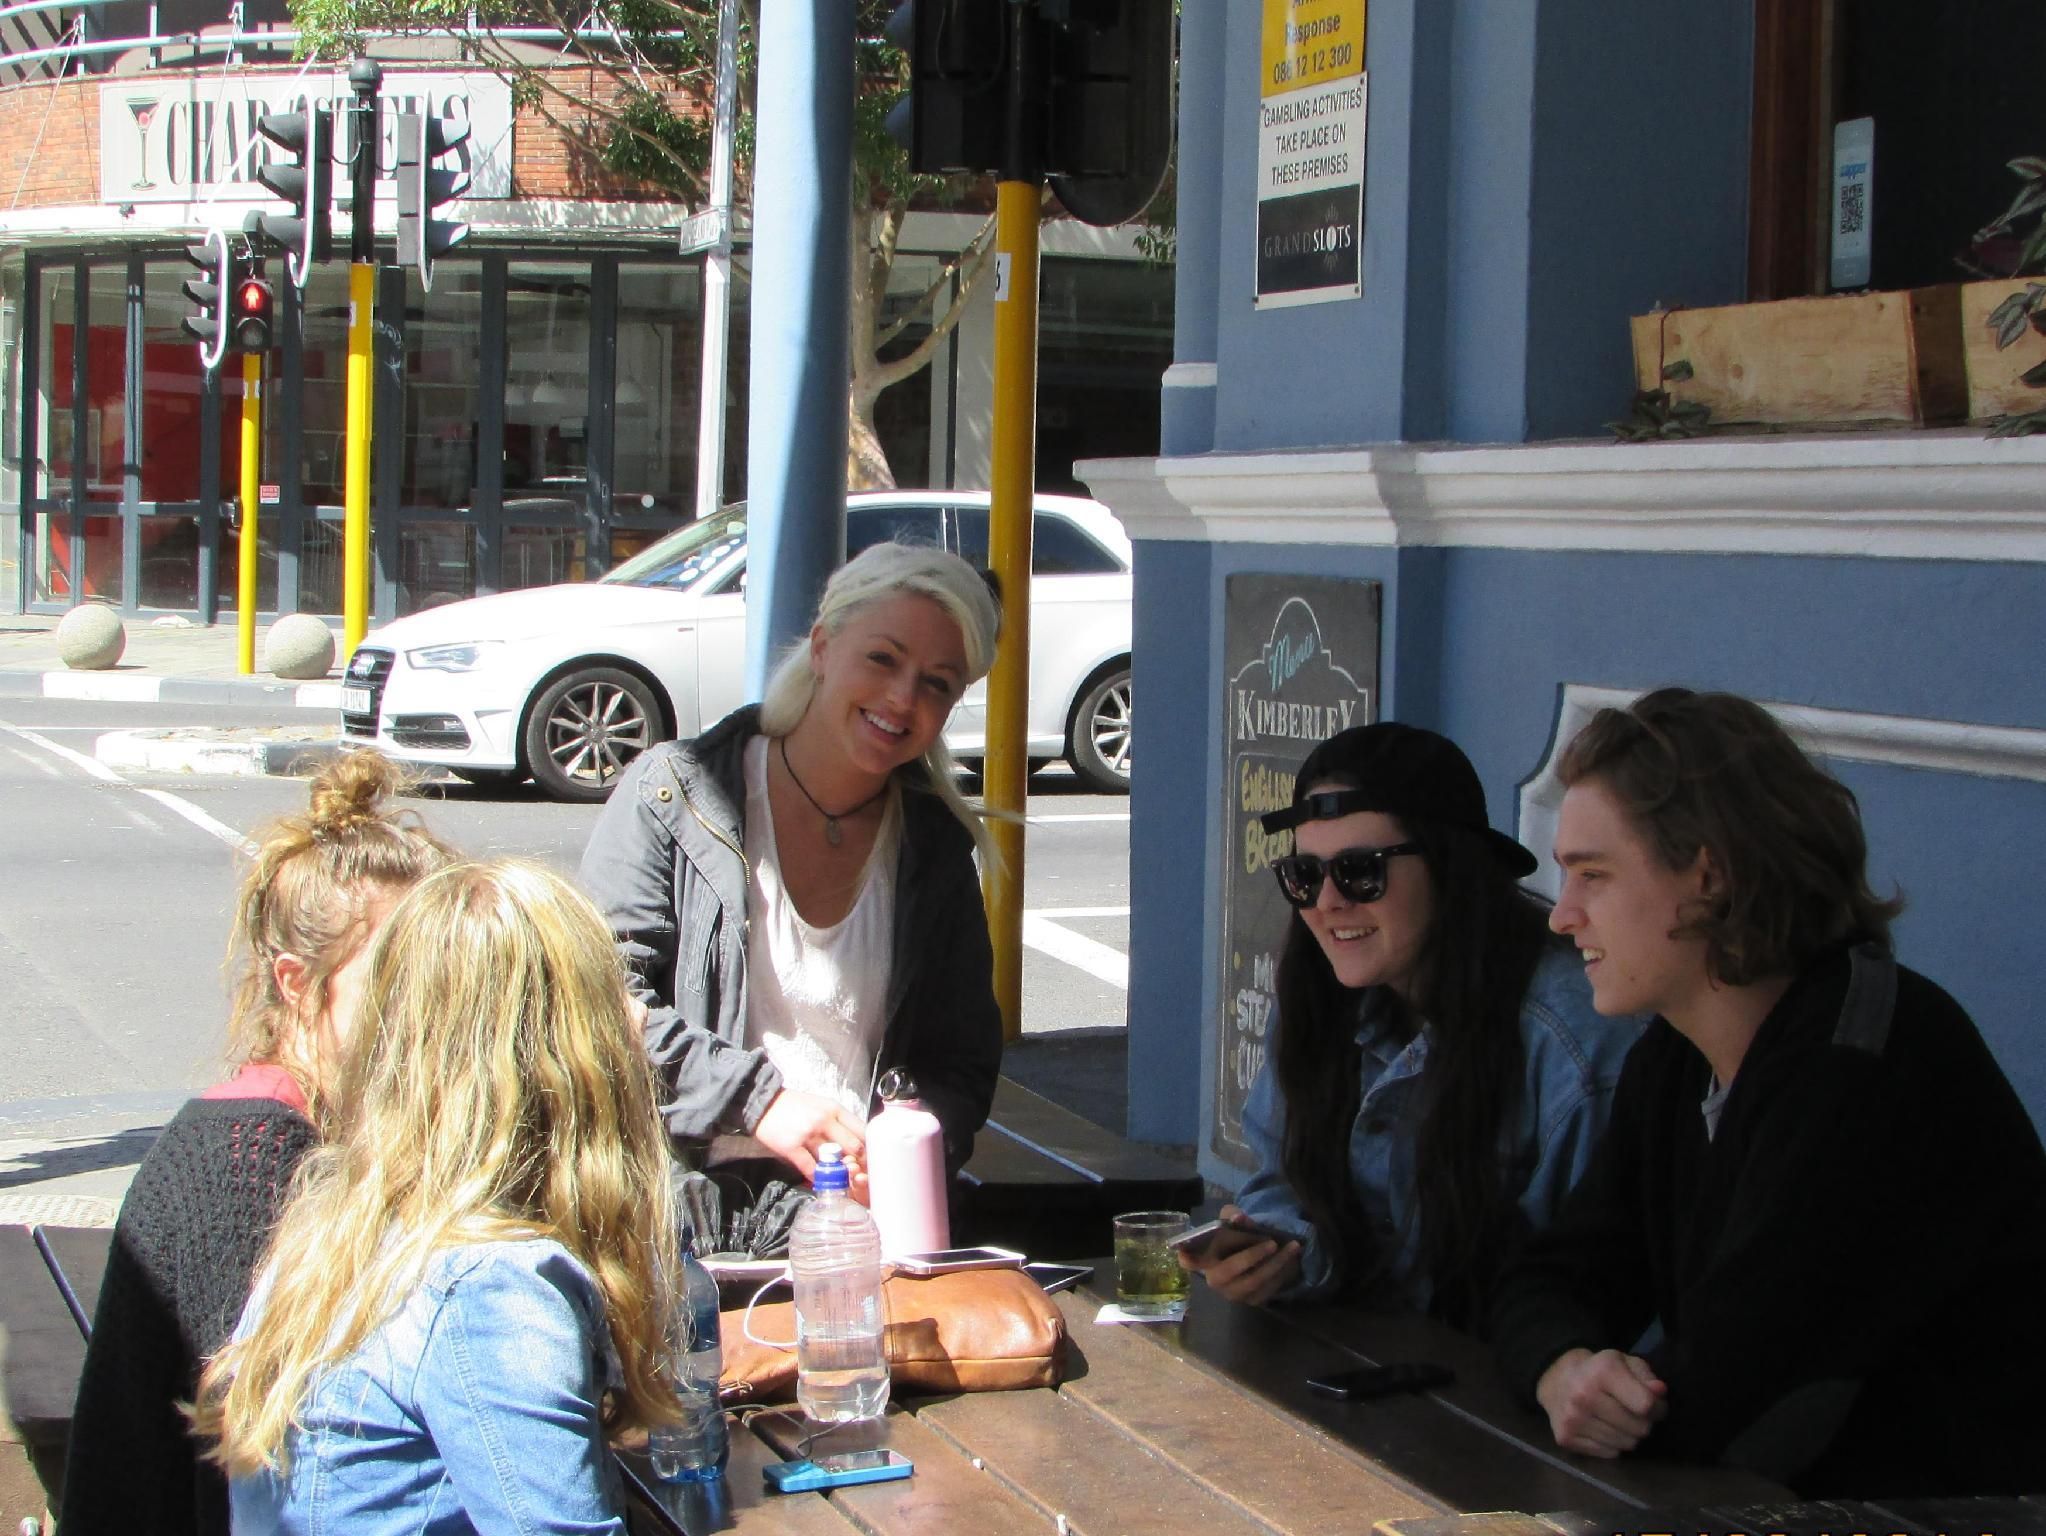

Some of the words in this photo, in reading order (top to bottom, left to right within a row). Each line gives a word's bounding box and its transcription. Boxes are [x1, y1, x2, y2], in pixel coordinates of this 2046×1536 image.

[1312, 49, 1325, 72] 12
[1329, 43, 1352, 68] 300
[1263, 99, 1310, 128] GAMBLING
[1312, 87, 1362, 117] ACTIVITIES
[166, 94, 470, 185] CHARTES
[1275, 132, 1298, 155] TAKE
[1300, 125, 1330, 151] PLACE
[1332, 122, 1346, 144] ON
[1272, 161, 1300, 185] THESE
[1302, 152, 1348, 180] PREMISES
[1237, 689, 1357, 741] KIMBERLEY
[1245, 819, 1294, 874] BREA
